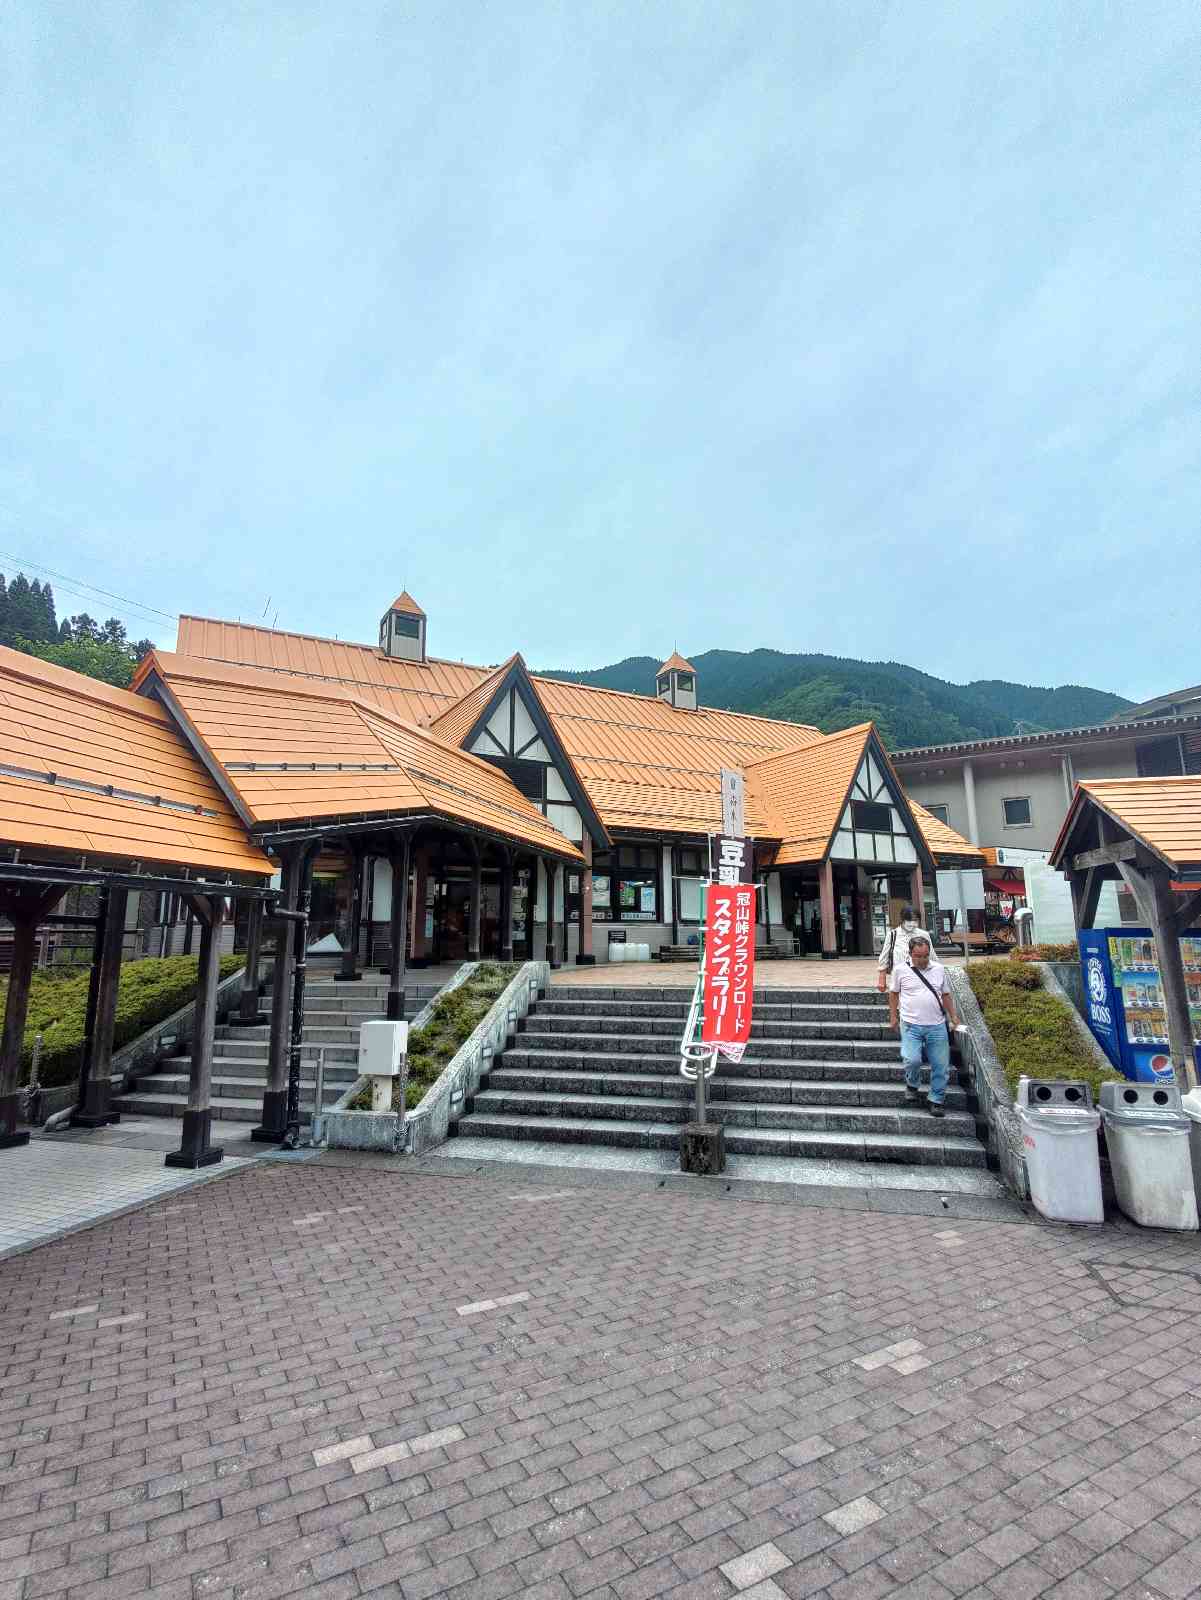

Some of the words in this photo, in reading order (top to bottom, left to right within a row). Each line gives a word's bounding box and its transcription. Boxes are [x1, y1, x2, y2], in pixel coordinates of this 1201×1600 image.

[711, 898, 732, 1035] スタンプラリー
[733, 892, 751, 1034] 冠山峠クラウンロード
[1091, 1004, 1112, 1024] BOSS
